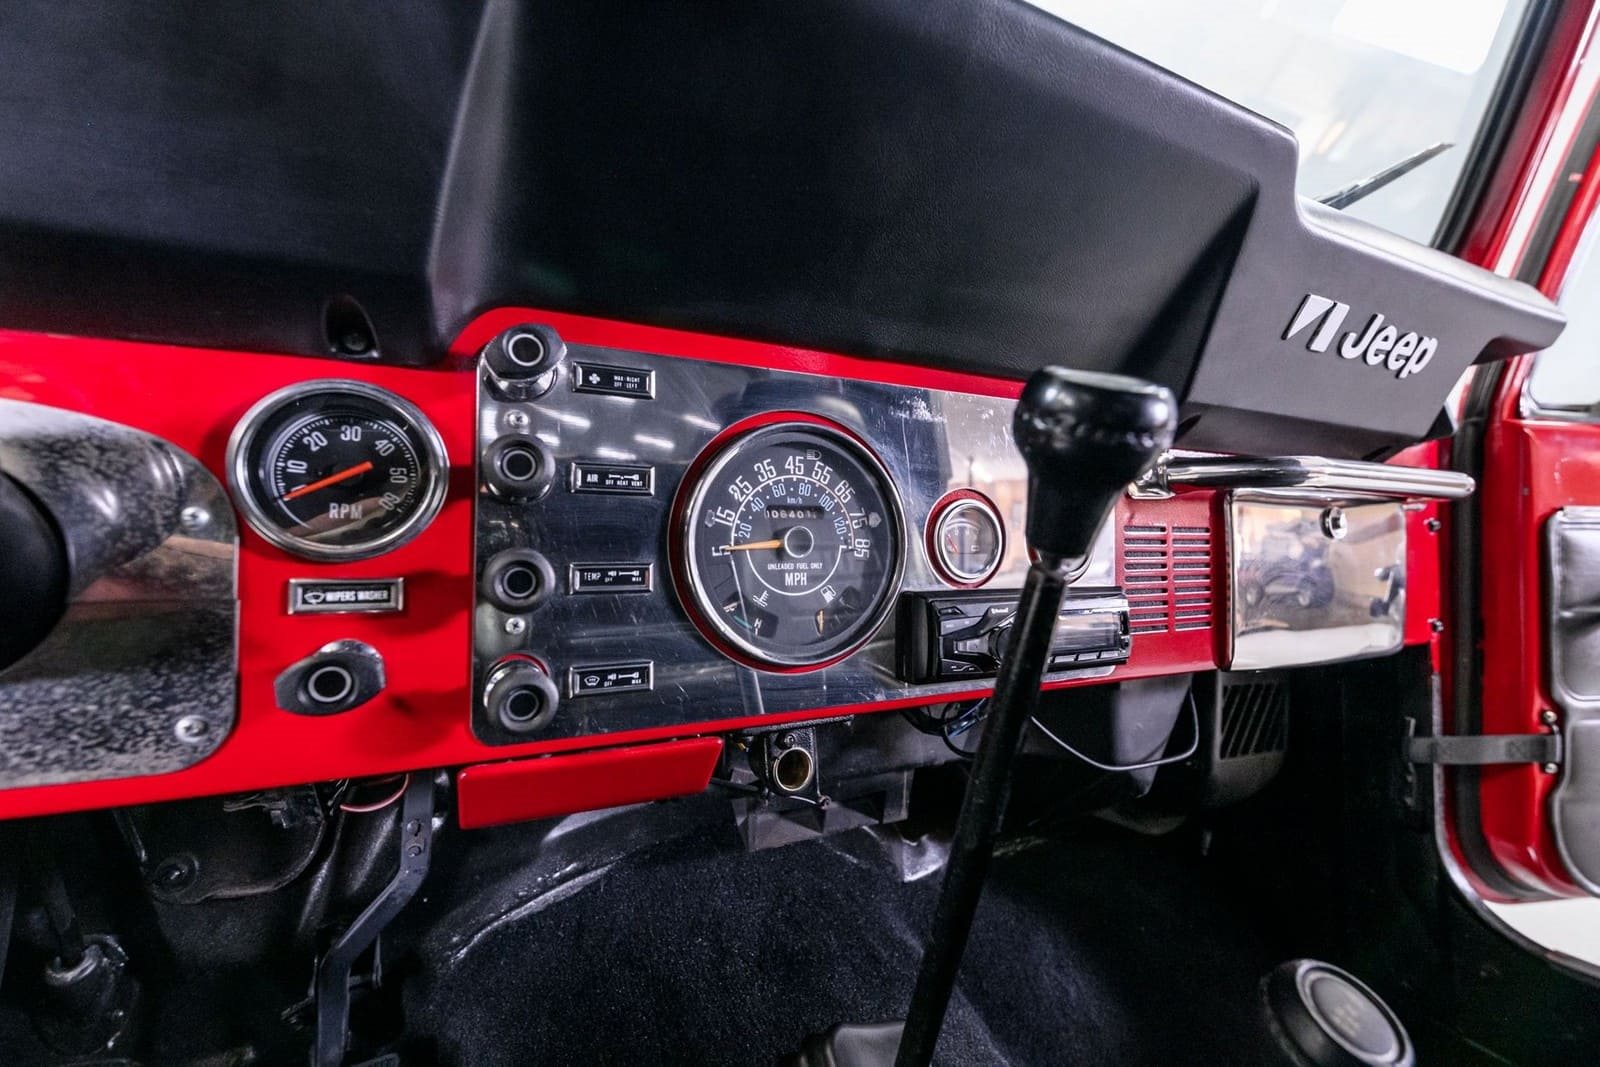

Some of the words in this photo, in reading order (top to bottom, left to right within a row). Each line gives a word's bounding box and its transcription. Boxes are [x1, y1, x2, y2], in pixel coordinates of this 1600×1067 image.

[1338, 313, 1438, 379] Jeep
[303, 431, 328, 452] 20
[340, 425, 362, 442] 30
[374, 438, 395, 456] 40
[286, 459, 308, 474] 10
[754, 458, 777, 480] 35
[785, 455, 805, 475] 45
[811, 460, 833, 482] 55
[389, 467, 407, 484] 50
[586, 473, 598, 483] AIR
[728, 475, 753, 502] 25
[772, 483, 786, 499] 60
[798, 481, 811, 497] 80
[833, 479, 856, 503] 65
[379, 491, 400, 511] 60
[750, 496, 765, 513] 40
[818, 493, 835, 512] 100
[328, 502, 363, 520] RPM
[712, 505, 736, 527] 15
[849, 507, 868, 529] 75
[738, 523, 752, 539] 20
[832, 516, 847, 535] 120
[854, 537, 871, 561] 85
[767, 563, 795, 571] UNLEADED
[796, 562, 809, 570] FUEL
[810, 562, 823, 570] ONLY
[584, 572, 601, 581] TEMP
[785, 572, 807, 586] MPH
[325, 590, 356, 602] WIPERS
[357, 590, 388, 601] WASHER
